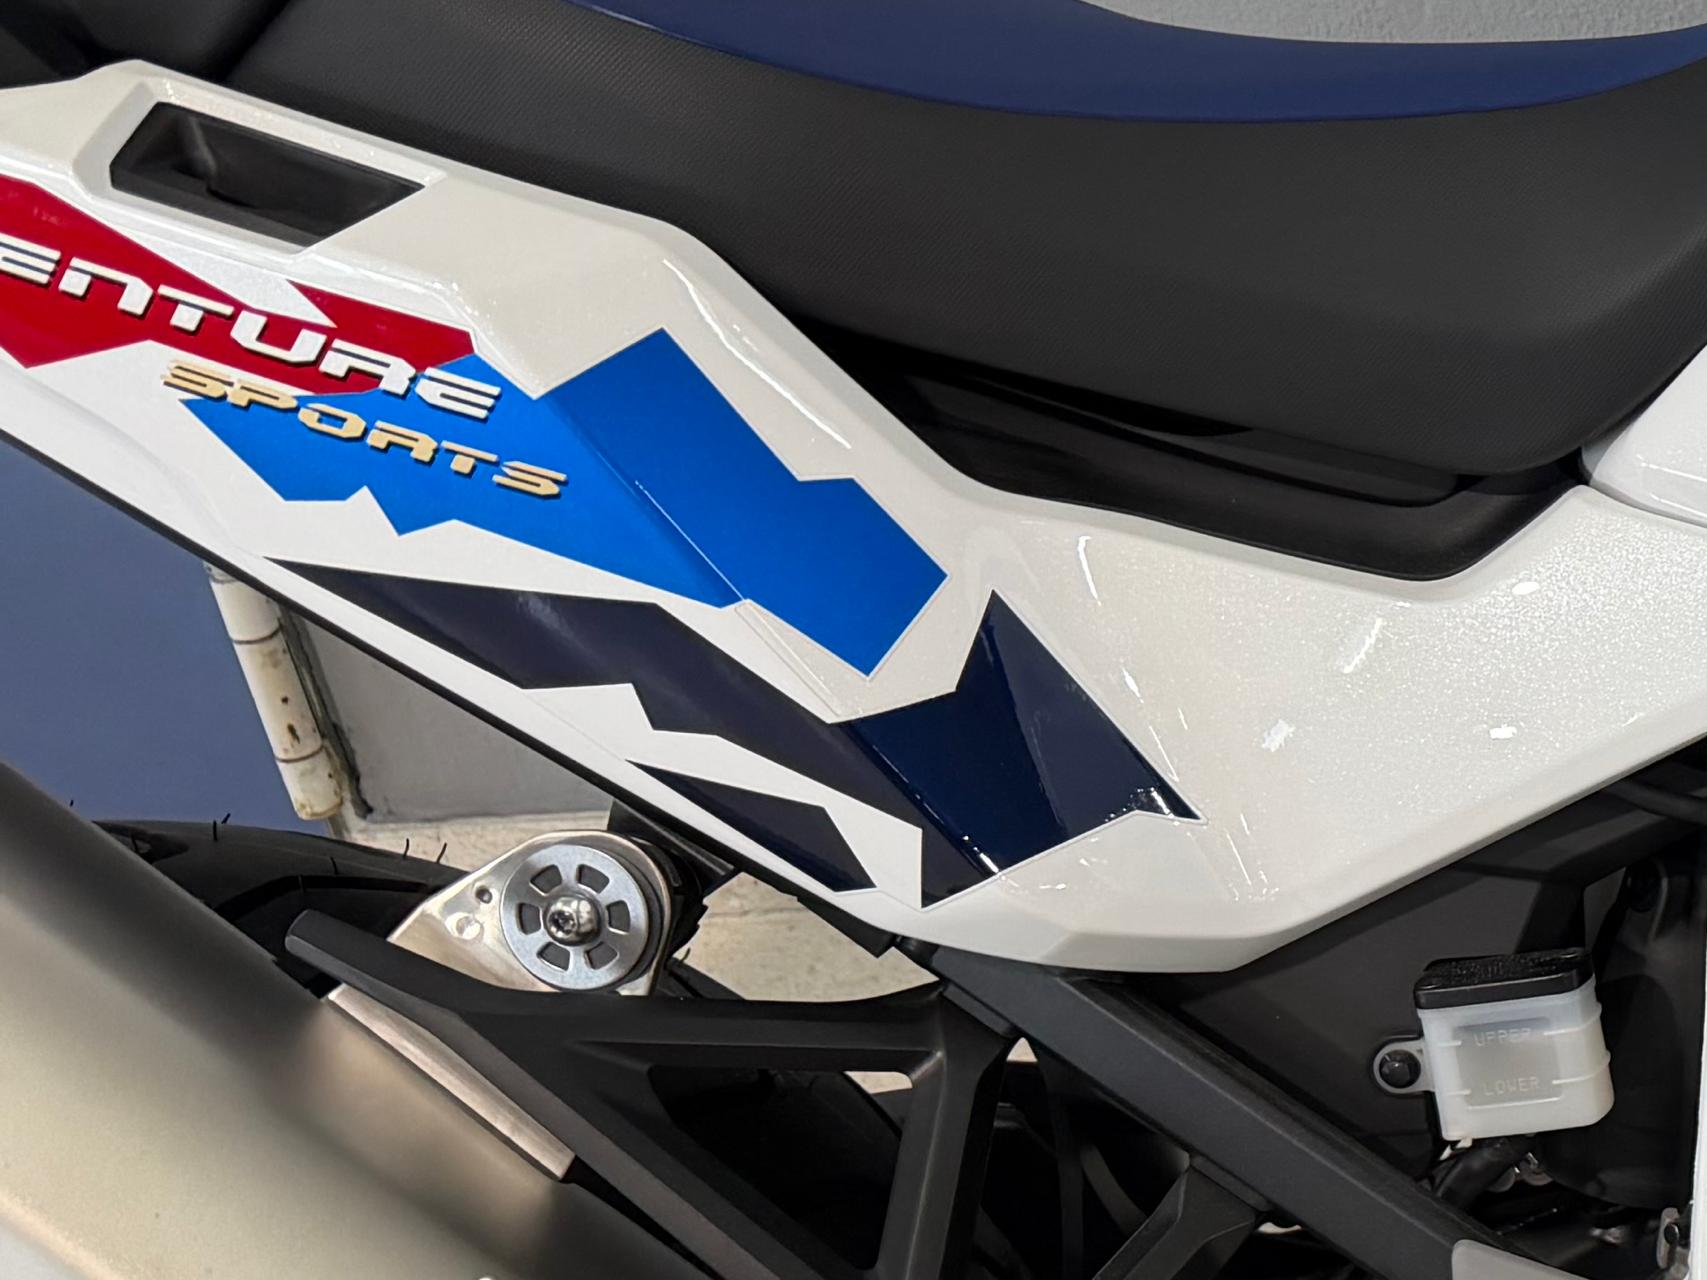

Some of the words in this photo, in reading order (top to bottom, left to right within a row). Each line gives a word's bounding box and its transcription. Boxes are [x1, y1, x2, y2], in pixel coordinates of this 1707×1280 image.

[160, 358, 570, 498] SPORTS
[1473, 1027, 1533, 1048] UPPER
[1481, 1075, 1542, 1097] LOWER
